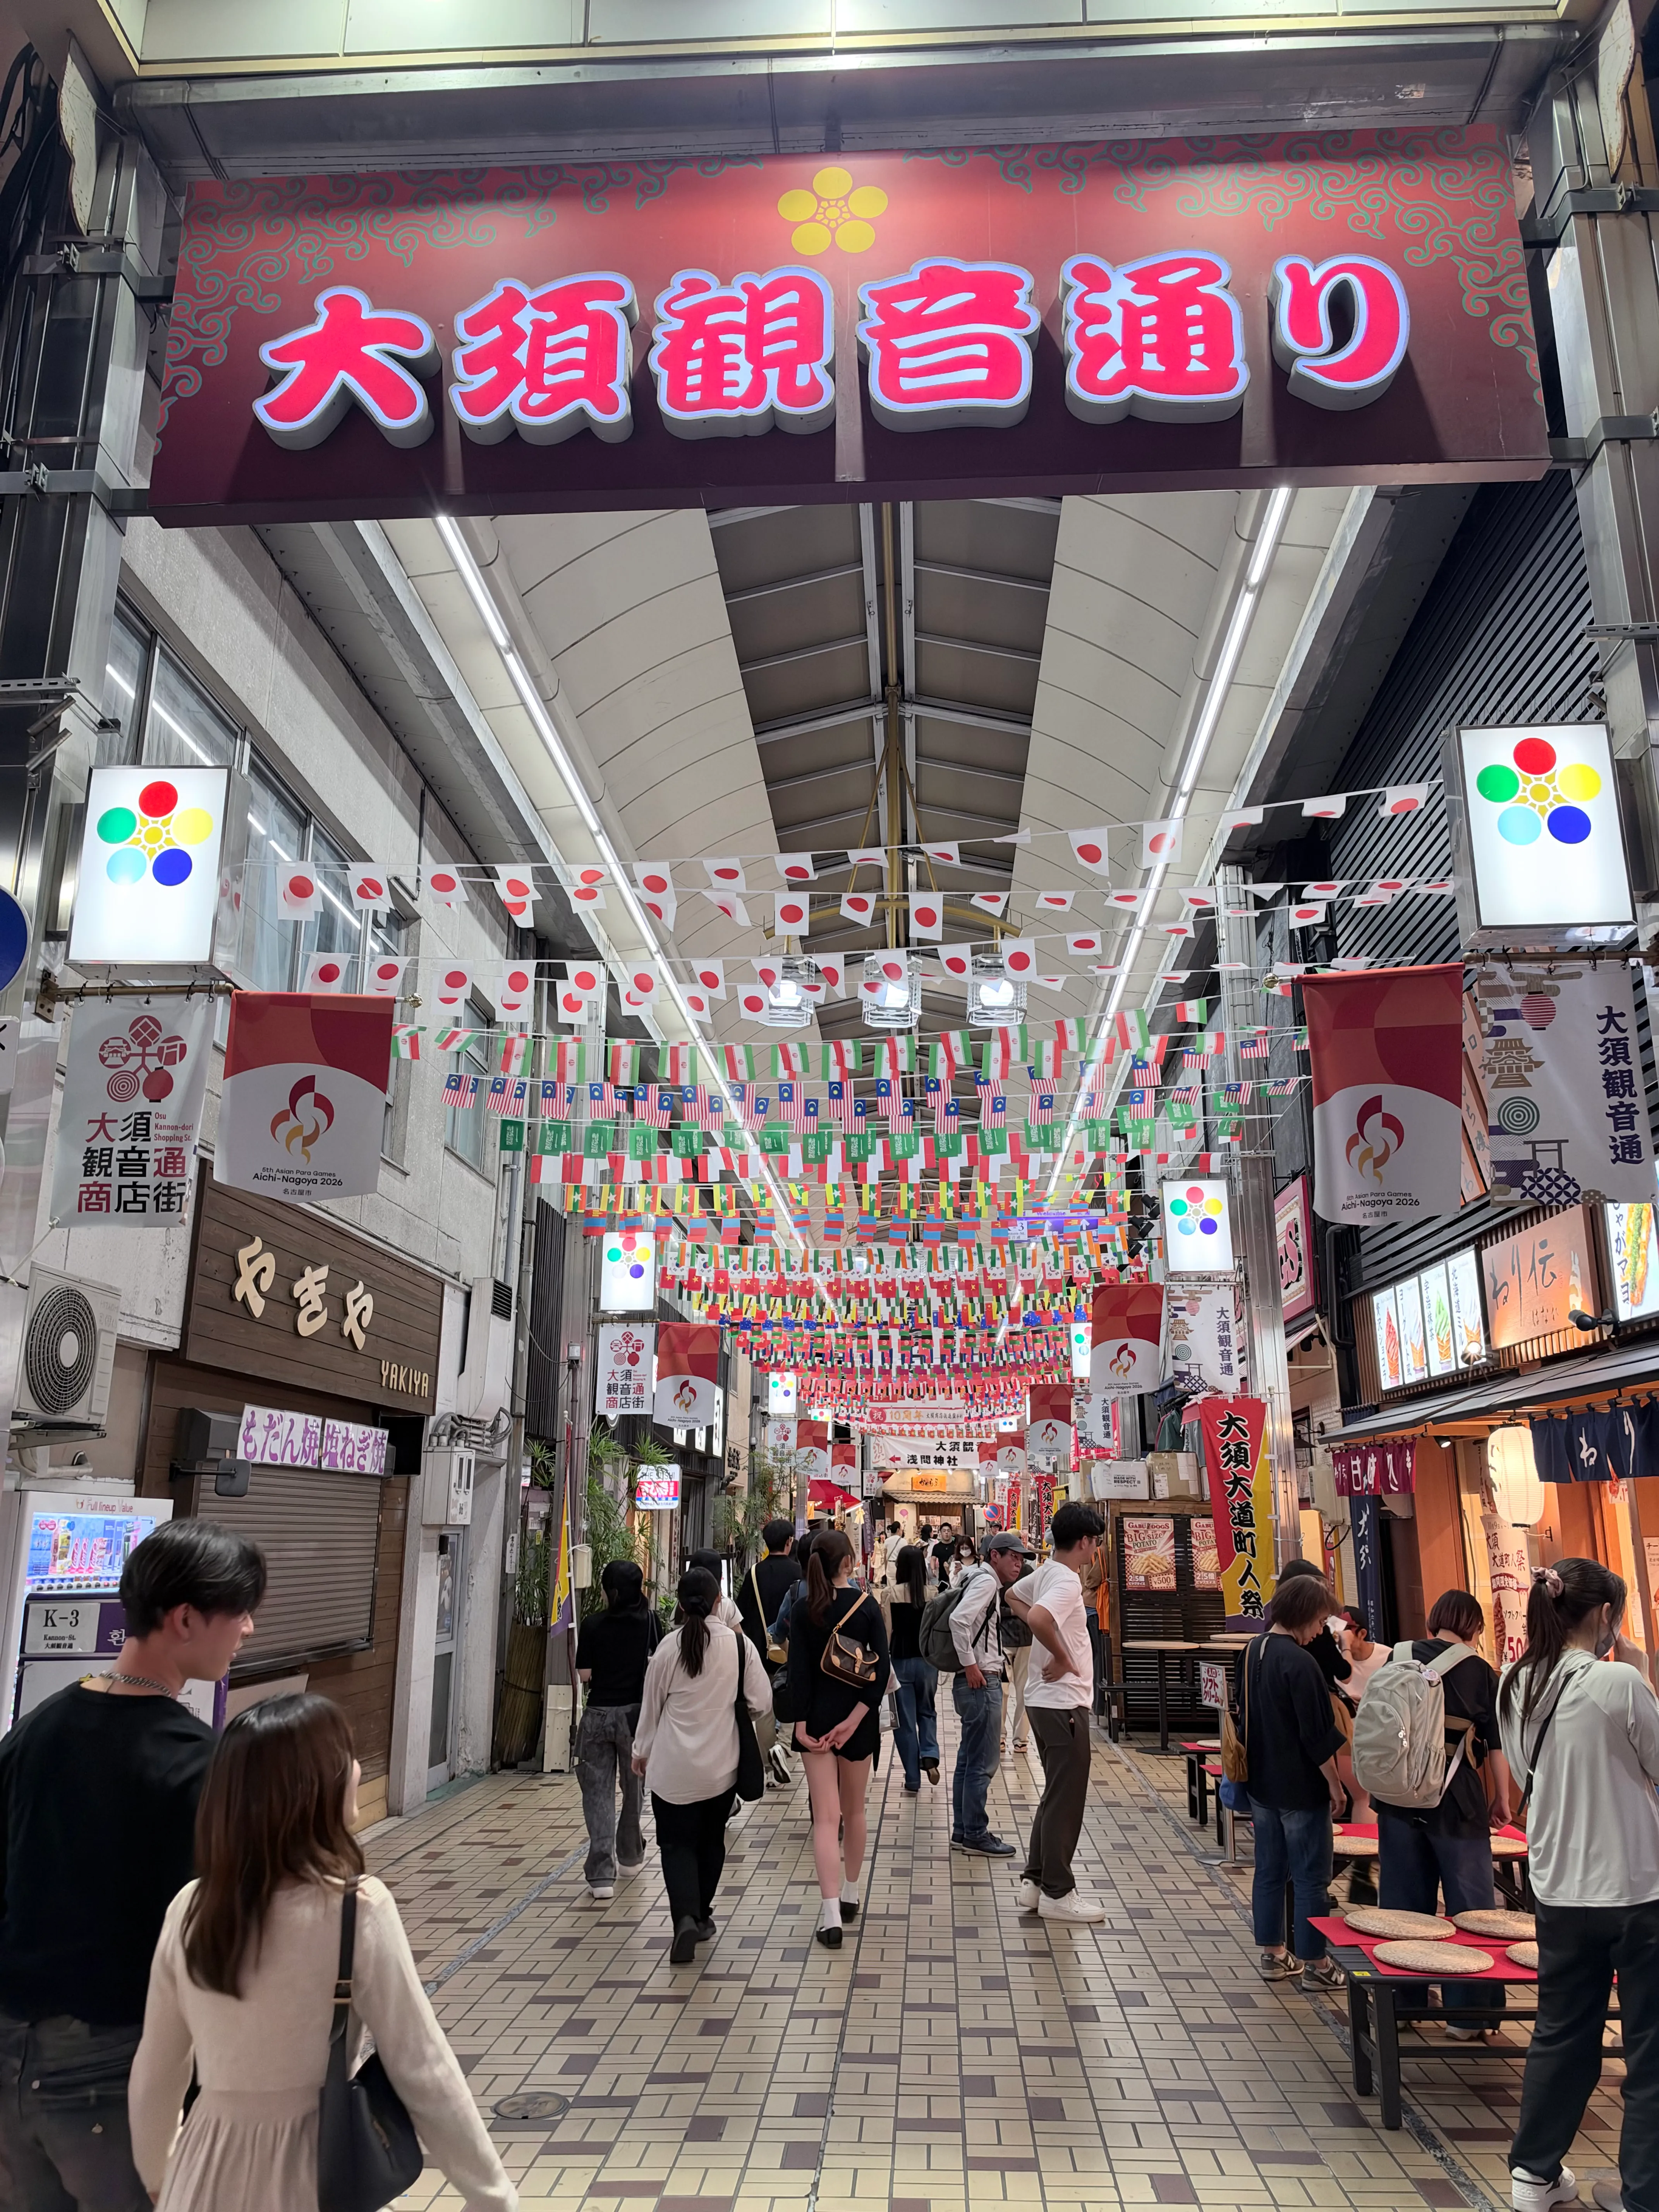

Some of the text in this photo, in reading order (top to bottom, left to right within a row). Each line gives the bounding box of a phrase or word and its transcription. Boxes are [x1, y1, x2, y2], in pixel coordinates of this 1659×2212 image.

[252, 251, 1412, 436] 大須観音通り
[1596, 1005, 1645, 1165] 大須観音通
[85, 1111, 152, 1143] 大須
[154, 1133, 183, 1142] Shopping
[82, 1145, 187, 1178] 観音通
[252, 1173, 343, 1186] Aichi-Nagoya 2026
[77, 1181, 186, 1213] 商店街
[283, 1188, 312, 1196] 名古屋市
[1341, 1198, 1420, 1211] Aichi-Nagoya 2026
[232, 1236, 373, 1351] やきや
[1216, 1307, 1234, 1376] 大須観音通
[380, 1360, 429, 1398] YAKIYA
[607, 1369, 632, 1382] 大須
[606, 1382, 644, 1395] 観音通
[606, 1396, 645, 1409] 商店街
[873, 1410, 884, 1421] 祝
[890, 1410, 924, 1421] 10周年
[1101, 1398, 1111, 1439] 大須観音通
[242, 1410, 319, 1466] もだん焼
[1579, 1410, 1635, 1474] ねり
[323, 1423, 386, 1473] 塩ねぎ焼
[935, 1441, 987, 1452] 大須観
[907, 1454, 958, 1466] 浅間神社
[99, 1501, 116, 1514] lineup
[118, 1498, 133, 1513] Value
[1041, 1480, 1053, 1532] 大須大道
[1216, 1410, 1265, 1620] 大須大道町人祭
[1126, 1531, 1164, 1542] BIG size
[1194, 1531, 1211, 1541] BIG
[1132, 1539, 1157, 1549] POTATO
[1492, 1549, 1525, 1571] 大道町人祭
[1154, 1576, 1171, 1585] ¥500
[43, 1609, 79, 1627] K-3
[1207, 1668, 1216, 1676] 入口
[1202, 1677, 1219, 1692] ソフト
[1203, 1690, 1220, 1703] クリーム
